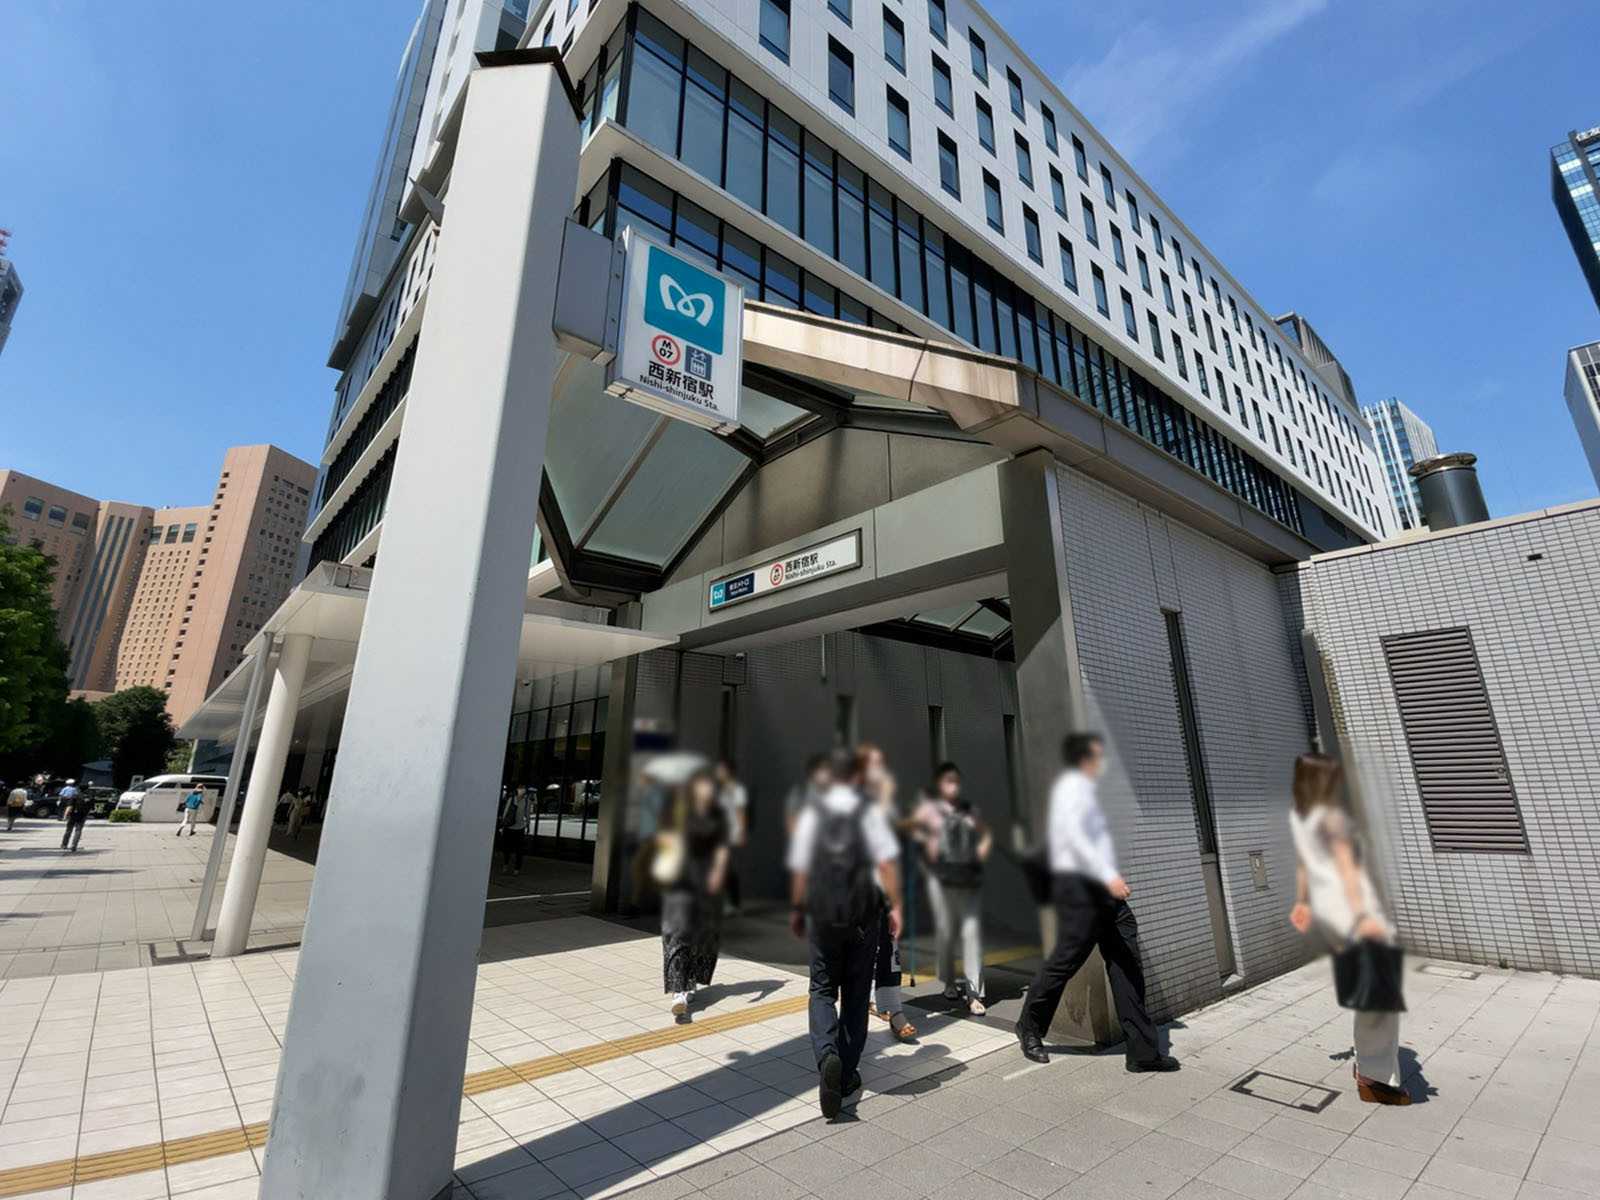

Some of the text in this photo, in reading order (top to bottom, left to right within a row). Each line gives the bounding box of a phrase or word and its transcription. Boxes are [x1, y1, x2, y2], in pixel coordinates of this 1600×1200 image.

[662, 340, 671, 349] M
[659, 348, 673, 358] 07
[648, 360, 714, 400] 西新宿駅
[639, 374, 720, 411] Nishi-shinjuku Sta.
[785, 552, 819, 573] 西新宿駅
[826, 560, 836, 568] Sta.
